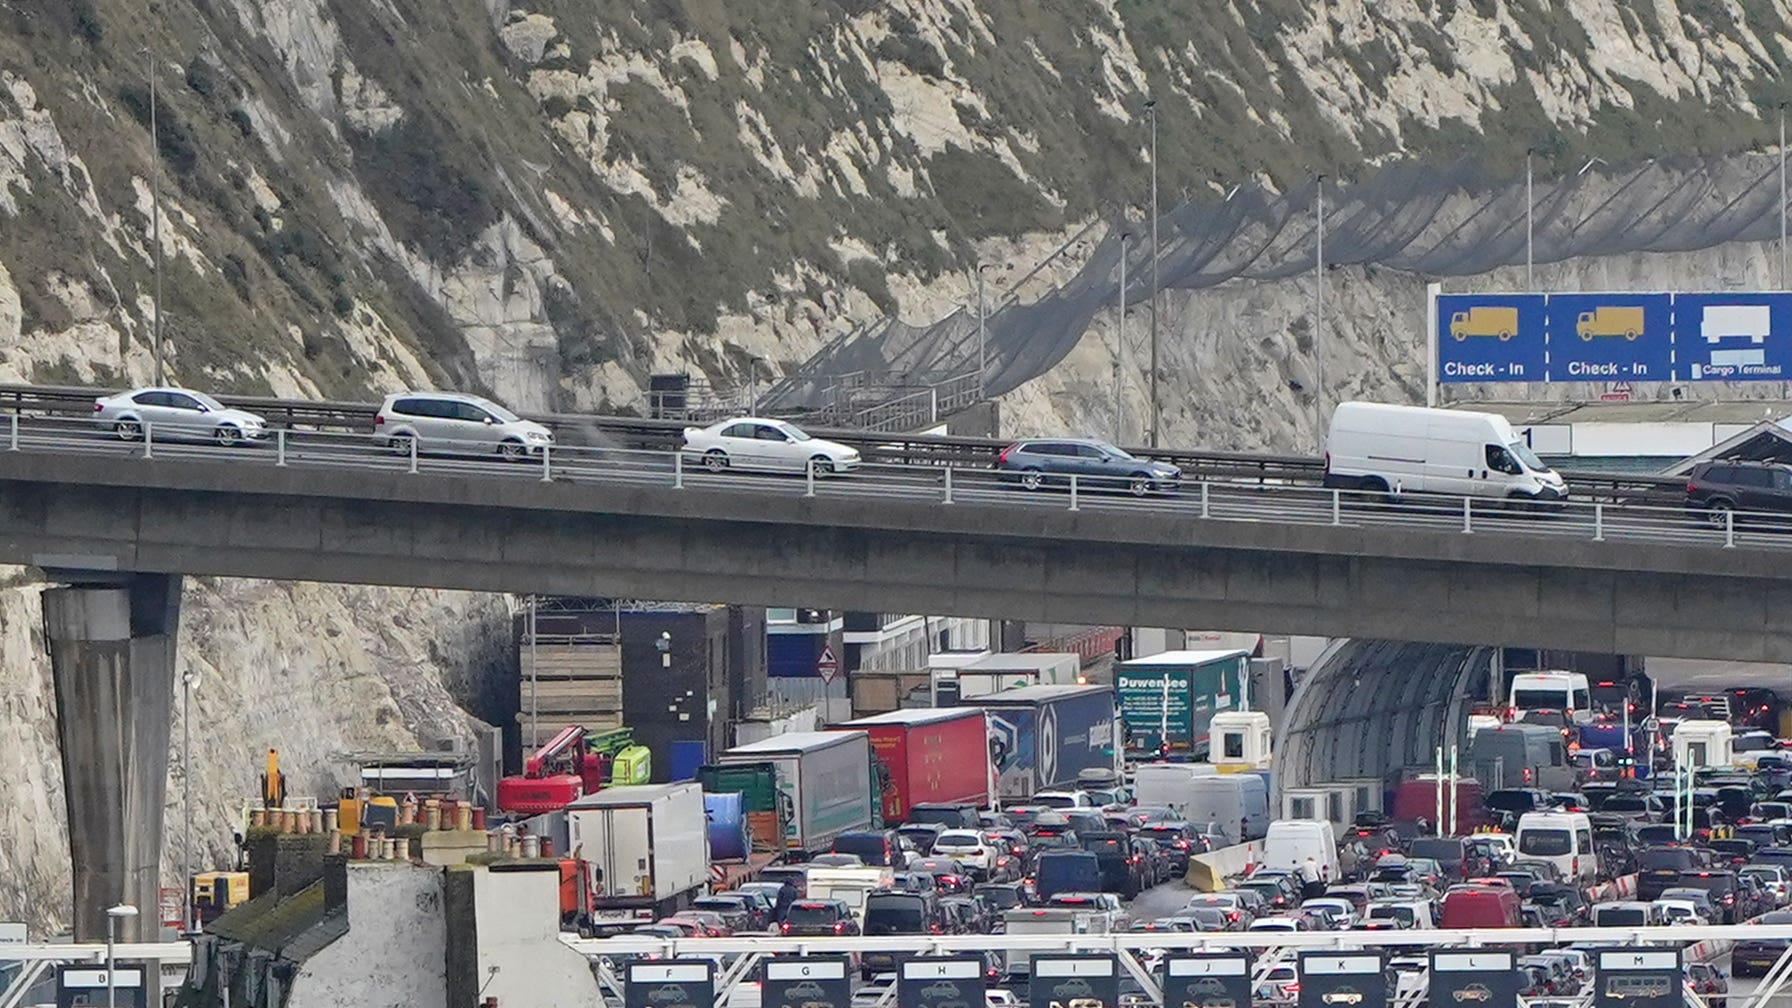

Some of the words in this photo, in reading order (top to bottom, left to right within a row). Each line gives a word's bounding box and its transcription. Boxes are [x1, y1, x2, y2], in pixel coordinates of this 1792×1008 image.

[1444, 362, 1494, 376] Check
[1509, 362, 1524, 376] In
[1568, 362, 1619, 376] Check
[1633, 362, 1648, 376] In
[1702, 364, 1735, 377] Cargo
[1738, 364, 1782, 375] Terminal
[1118, 676, 1188, 688] Duwenee
[1337, 960, 1346, 970] K
[1469, 956, 1475, 967] L
[1633, 955, 1644, 965] M
[801, 966, 810, 976] G
[938, 966, 947, 975] H
[1205, 961, 1211, 972] J
[665, 969, 672, 979] F
